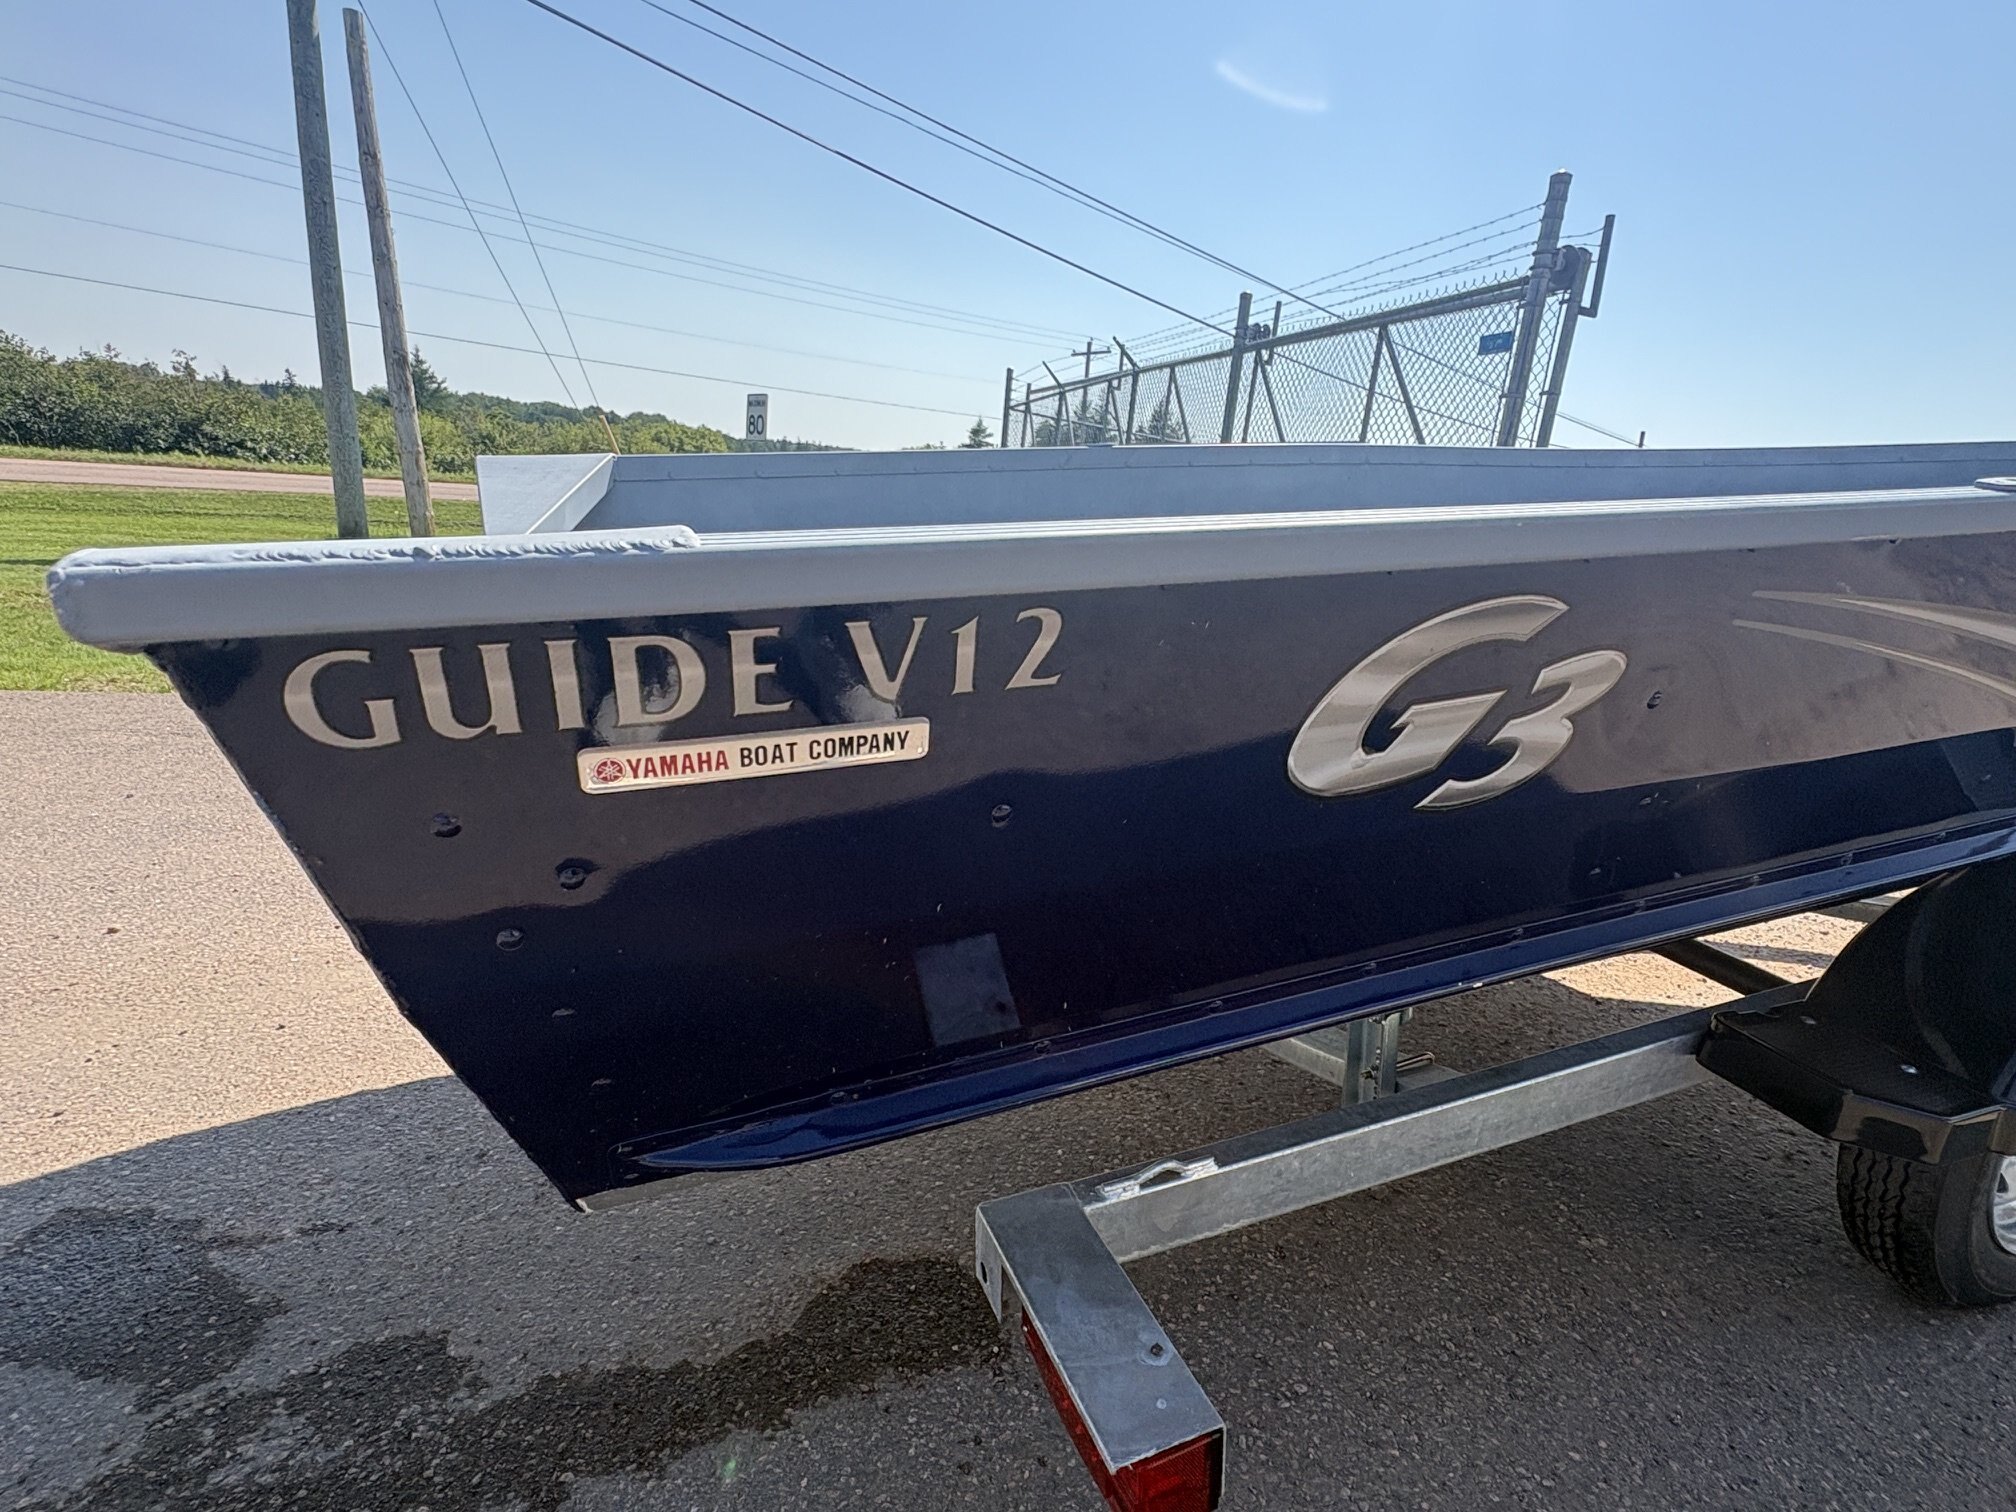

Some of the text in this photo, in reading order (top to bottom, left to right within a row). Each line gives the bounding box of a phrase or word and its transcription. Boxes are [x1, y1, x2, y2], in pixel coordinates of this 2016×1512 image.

[748, 414, 765, 435] 80
[283, 608, 1063, 749] GUIDE V12
[1288, 594, 1628, 810] G3
[627, 731, 910, 781] YAMAHA BOAT COMPANY
